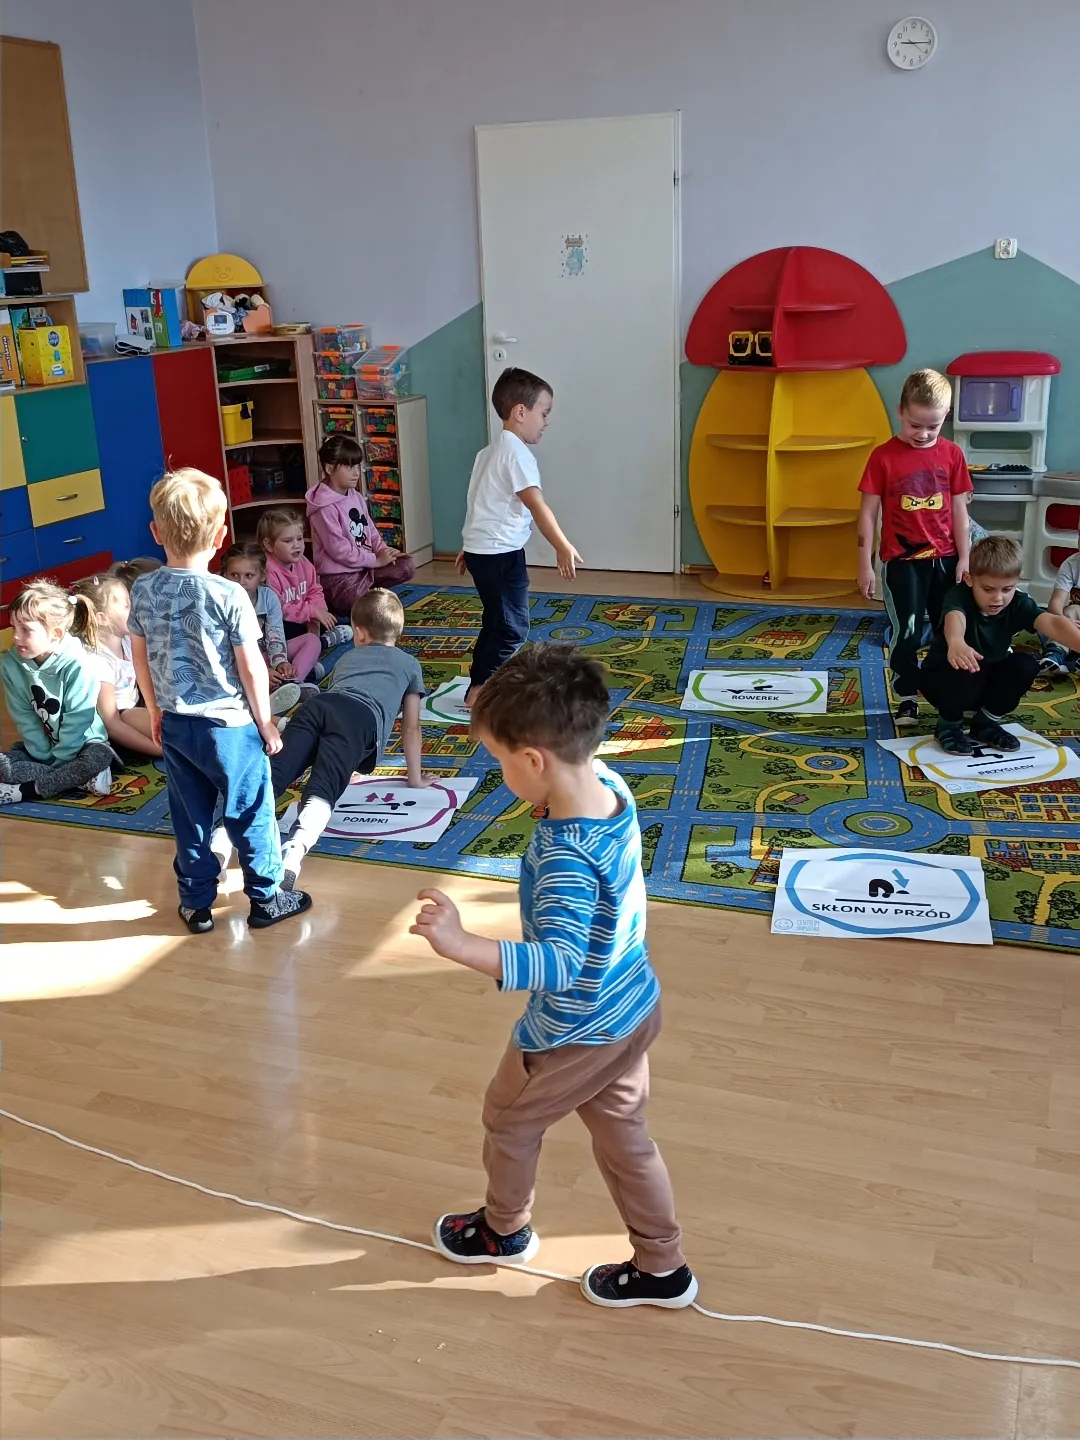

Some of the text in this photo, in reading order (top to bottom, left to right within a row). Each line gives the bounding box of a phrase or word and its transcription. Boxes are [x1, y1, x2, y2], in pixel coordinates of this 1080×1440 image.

[978, 764, 1034, 776] PRZYSIADY
[342, 816, 389, 824] POMPKI
[811, 903, 951, 919] SKŁON W PRZÓD
